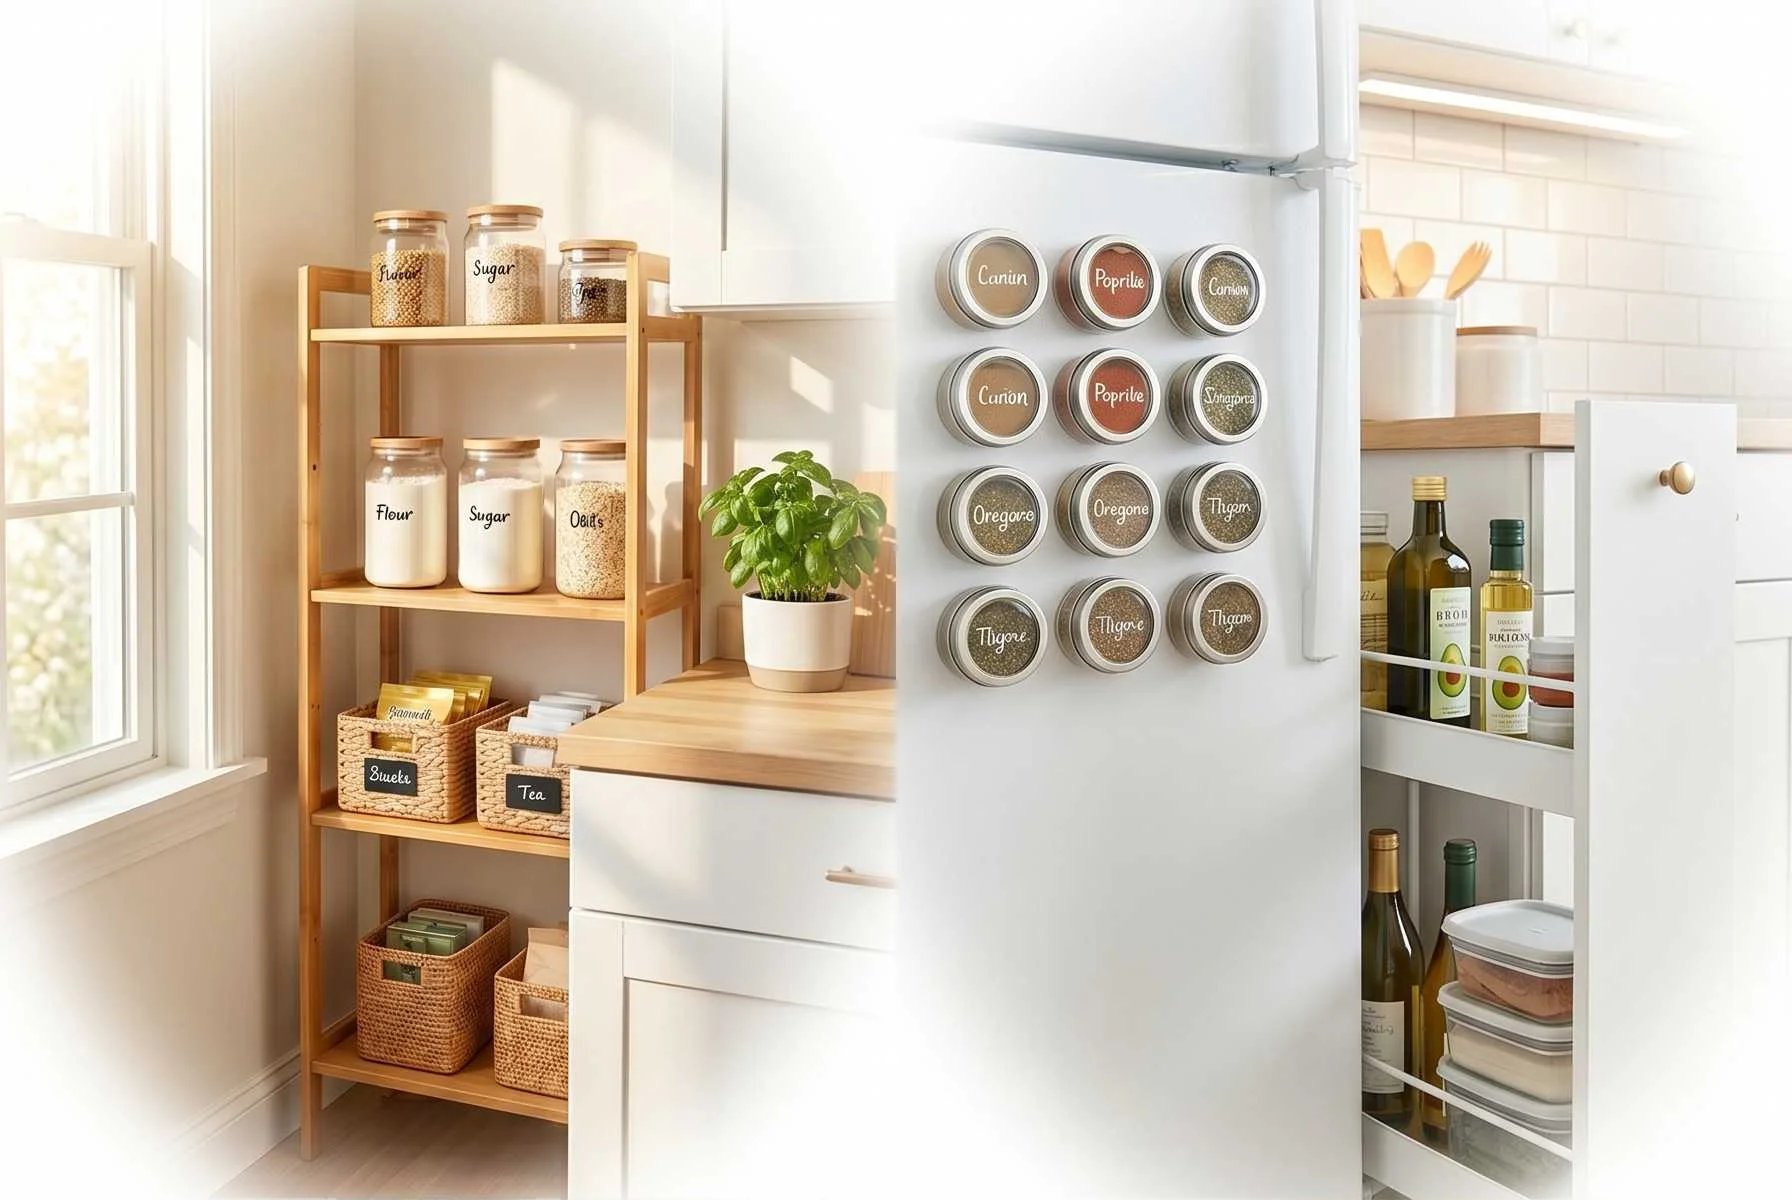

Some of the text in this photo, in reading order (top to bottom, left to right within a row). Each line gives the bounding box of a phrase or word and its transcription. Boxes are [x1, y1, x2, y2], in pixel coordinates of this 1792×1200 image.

[473, 259, 516, 284] Sugar
[376, 503, 414, 522] Flour
[469, 505, 511, 530] Sugar
[517, 784, 546, 801] Tea
